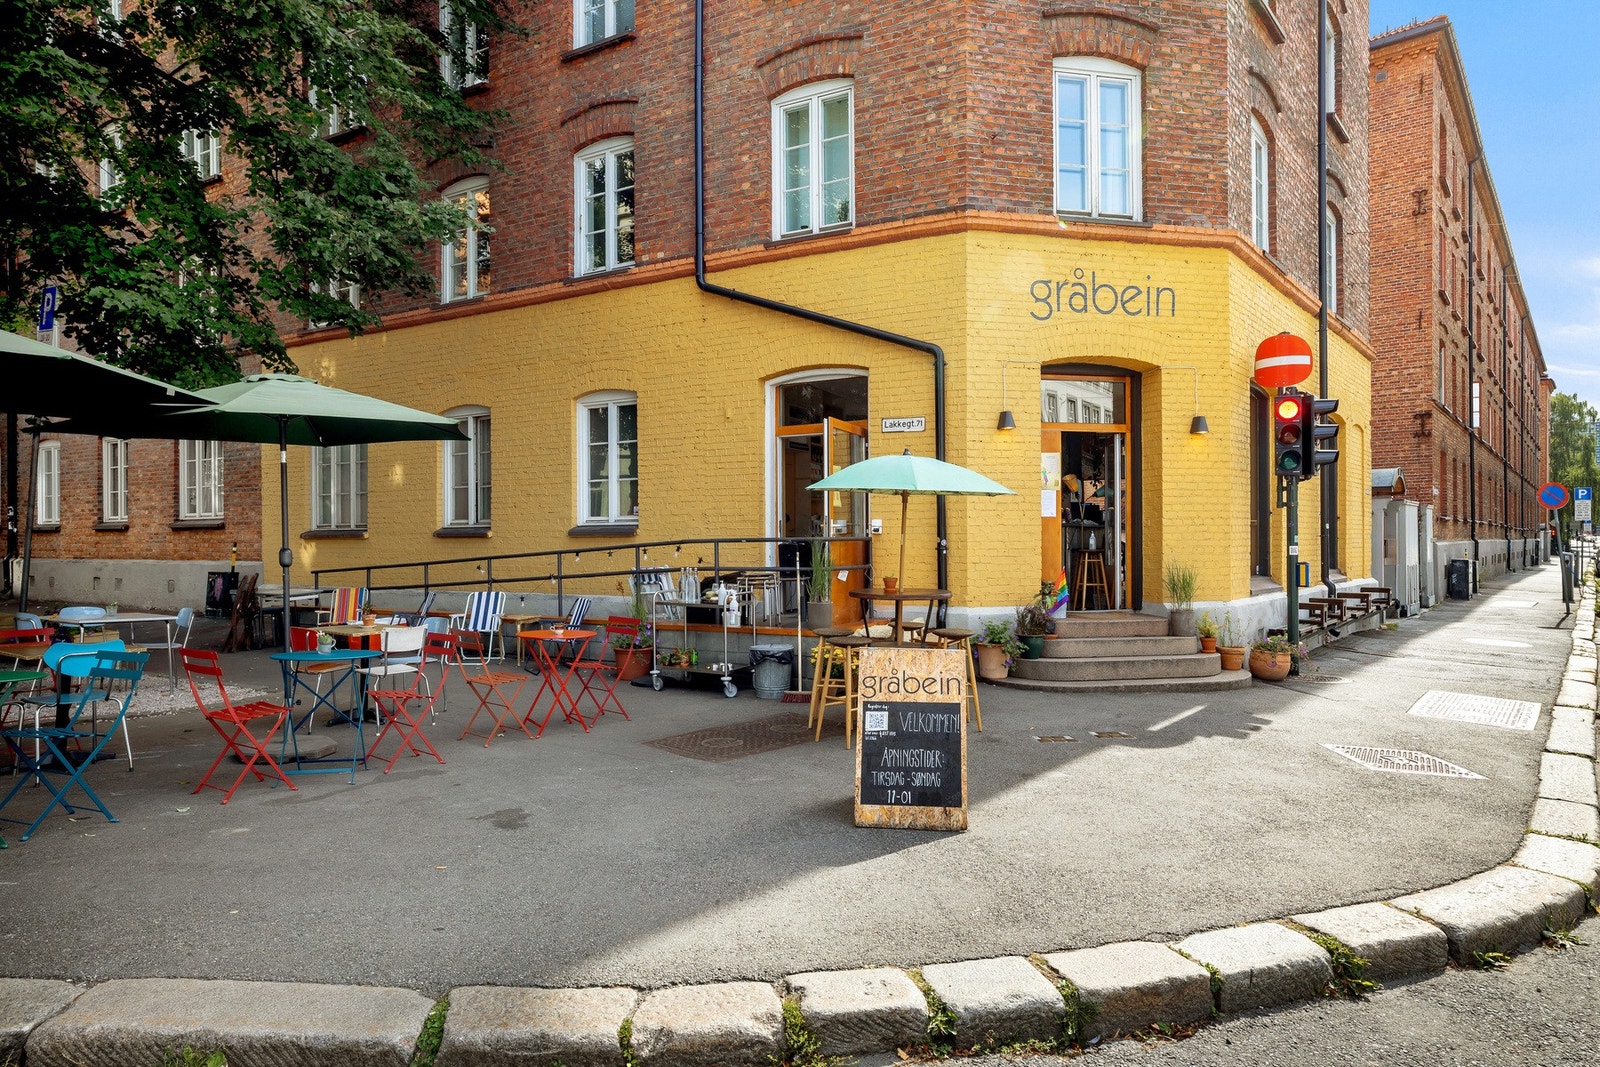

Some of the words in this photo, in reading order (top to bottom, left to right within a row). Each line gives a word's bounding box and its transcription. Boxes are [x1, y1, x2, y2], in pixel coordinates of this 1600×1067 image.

[1030, 267, 1176, 321] gråbein
[42, 292, 53, 325] P
[1578, 489, 1588, 499] P
[861, 668, 961, 699] gråbein
[899, 711, 960, 734] VELKOMMEN!
[881, 746, 945, 769] ÅPNINGSTIDER:
[871, 771, 905, 788] TIRSDAG
[911, 771, 941, 788] SØNDAG
[887, 789, 912, 804] 11-01
